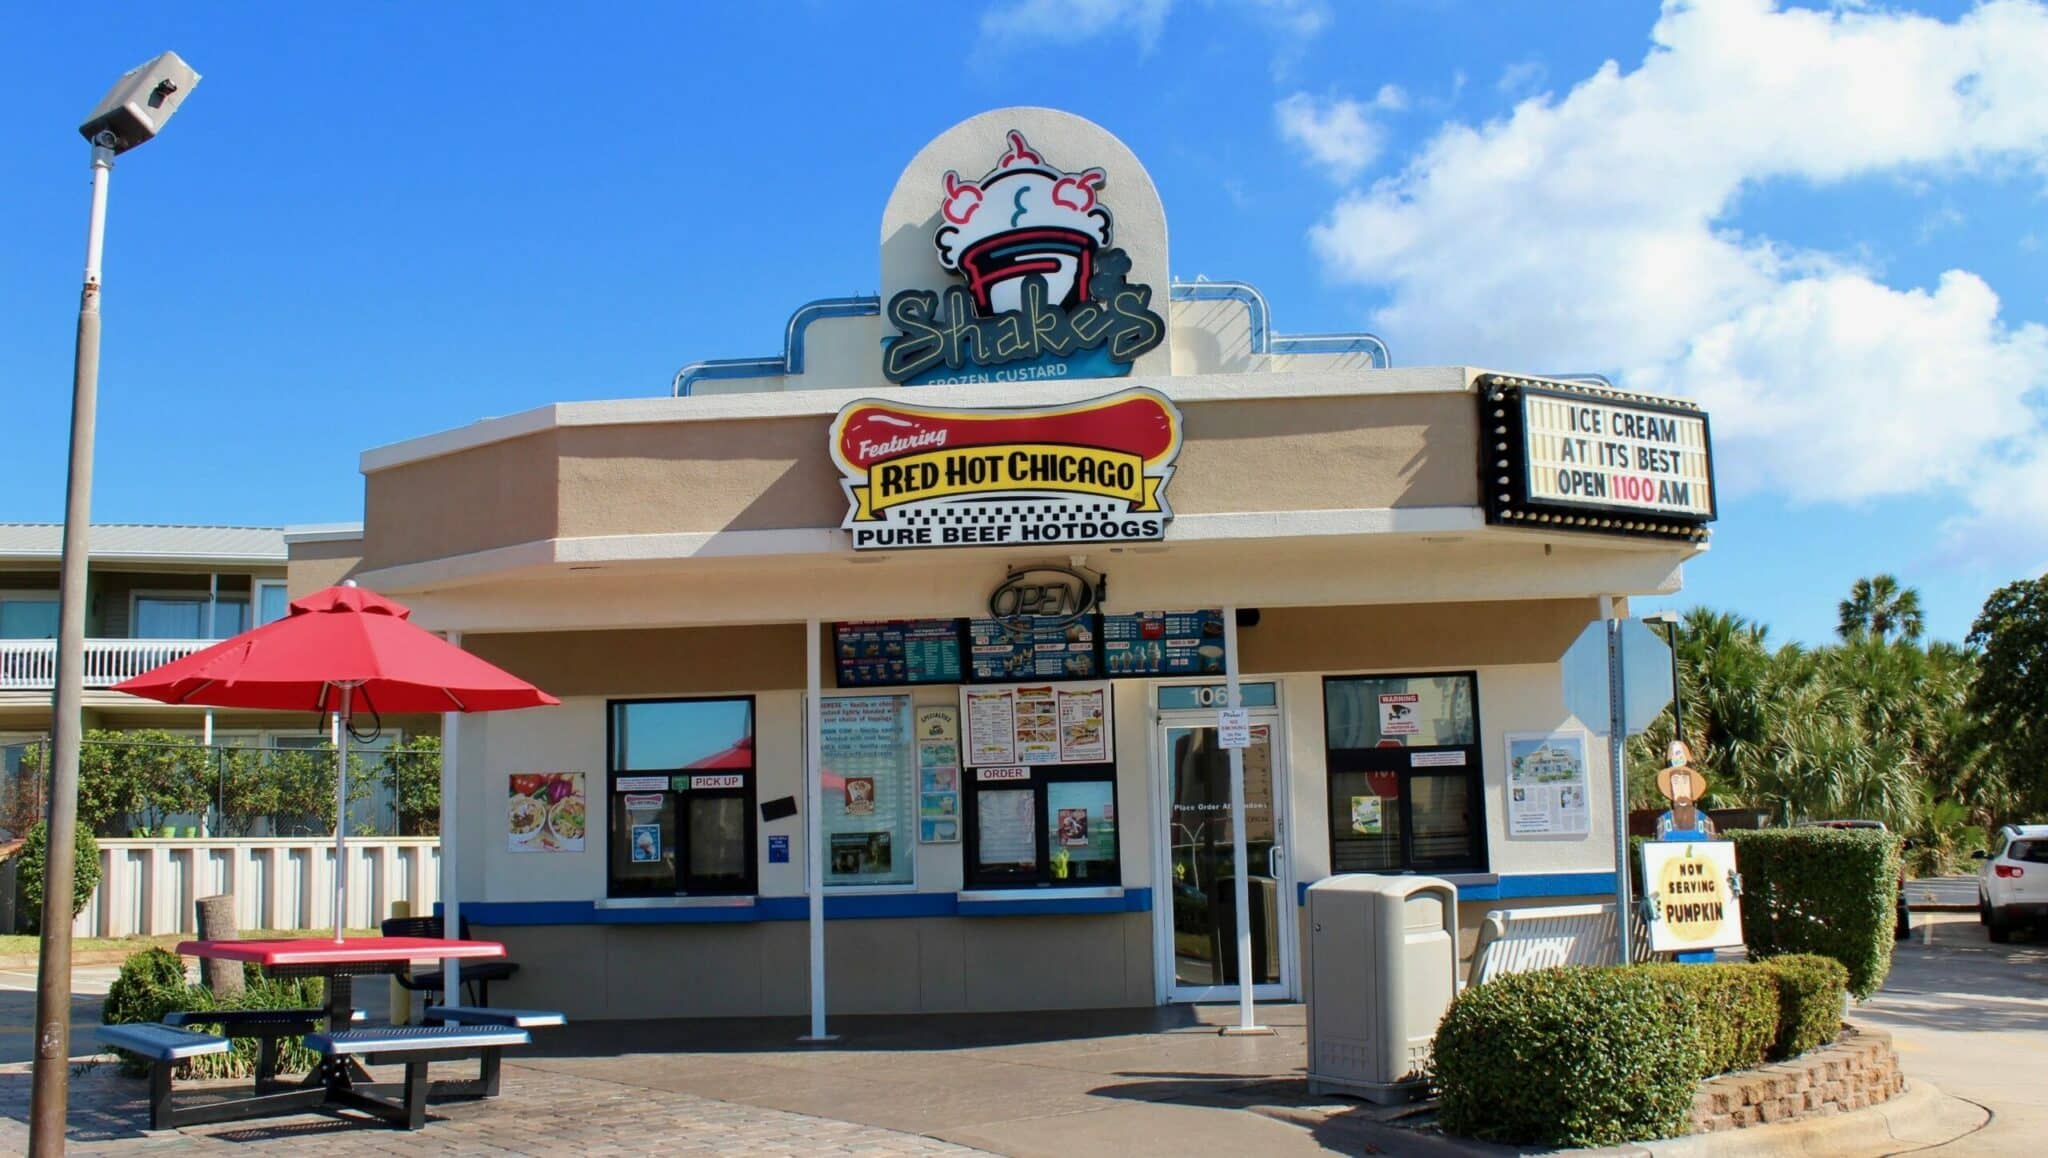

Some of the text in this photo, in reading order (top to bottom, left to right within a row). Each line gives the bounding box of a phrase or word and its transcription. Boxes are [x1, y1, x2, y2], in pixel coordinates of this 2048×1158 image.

[995, 363, 1067, 383] CUSTARD
[1571, 407, 1676, 443] ICE CREAM
[859, 427, 947, 459] Featuring
[1562, 438, 1680, 474] AT ITS BEST
[881, 451, 1134, 497] RED HOT CHICAGO
[1559, 469, 1690, 506] OPEN 1100 AM
[857, 519, 1159, 545] PURE BEEF HOTDOGS
[995, 583, 1083, 618] OPEN
[1189, 687, 1243, 705] 106
[695, 777, 719, 787] PICK
[724, 776, 738, 786] UP
[984, 769, 1023, 779] ORDER
[1679, 863, 1704, 876] NOW
[1668, 880, 1715, 894] SERVING
[1666, 902, 1724, 923] PUMPKIN
